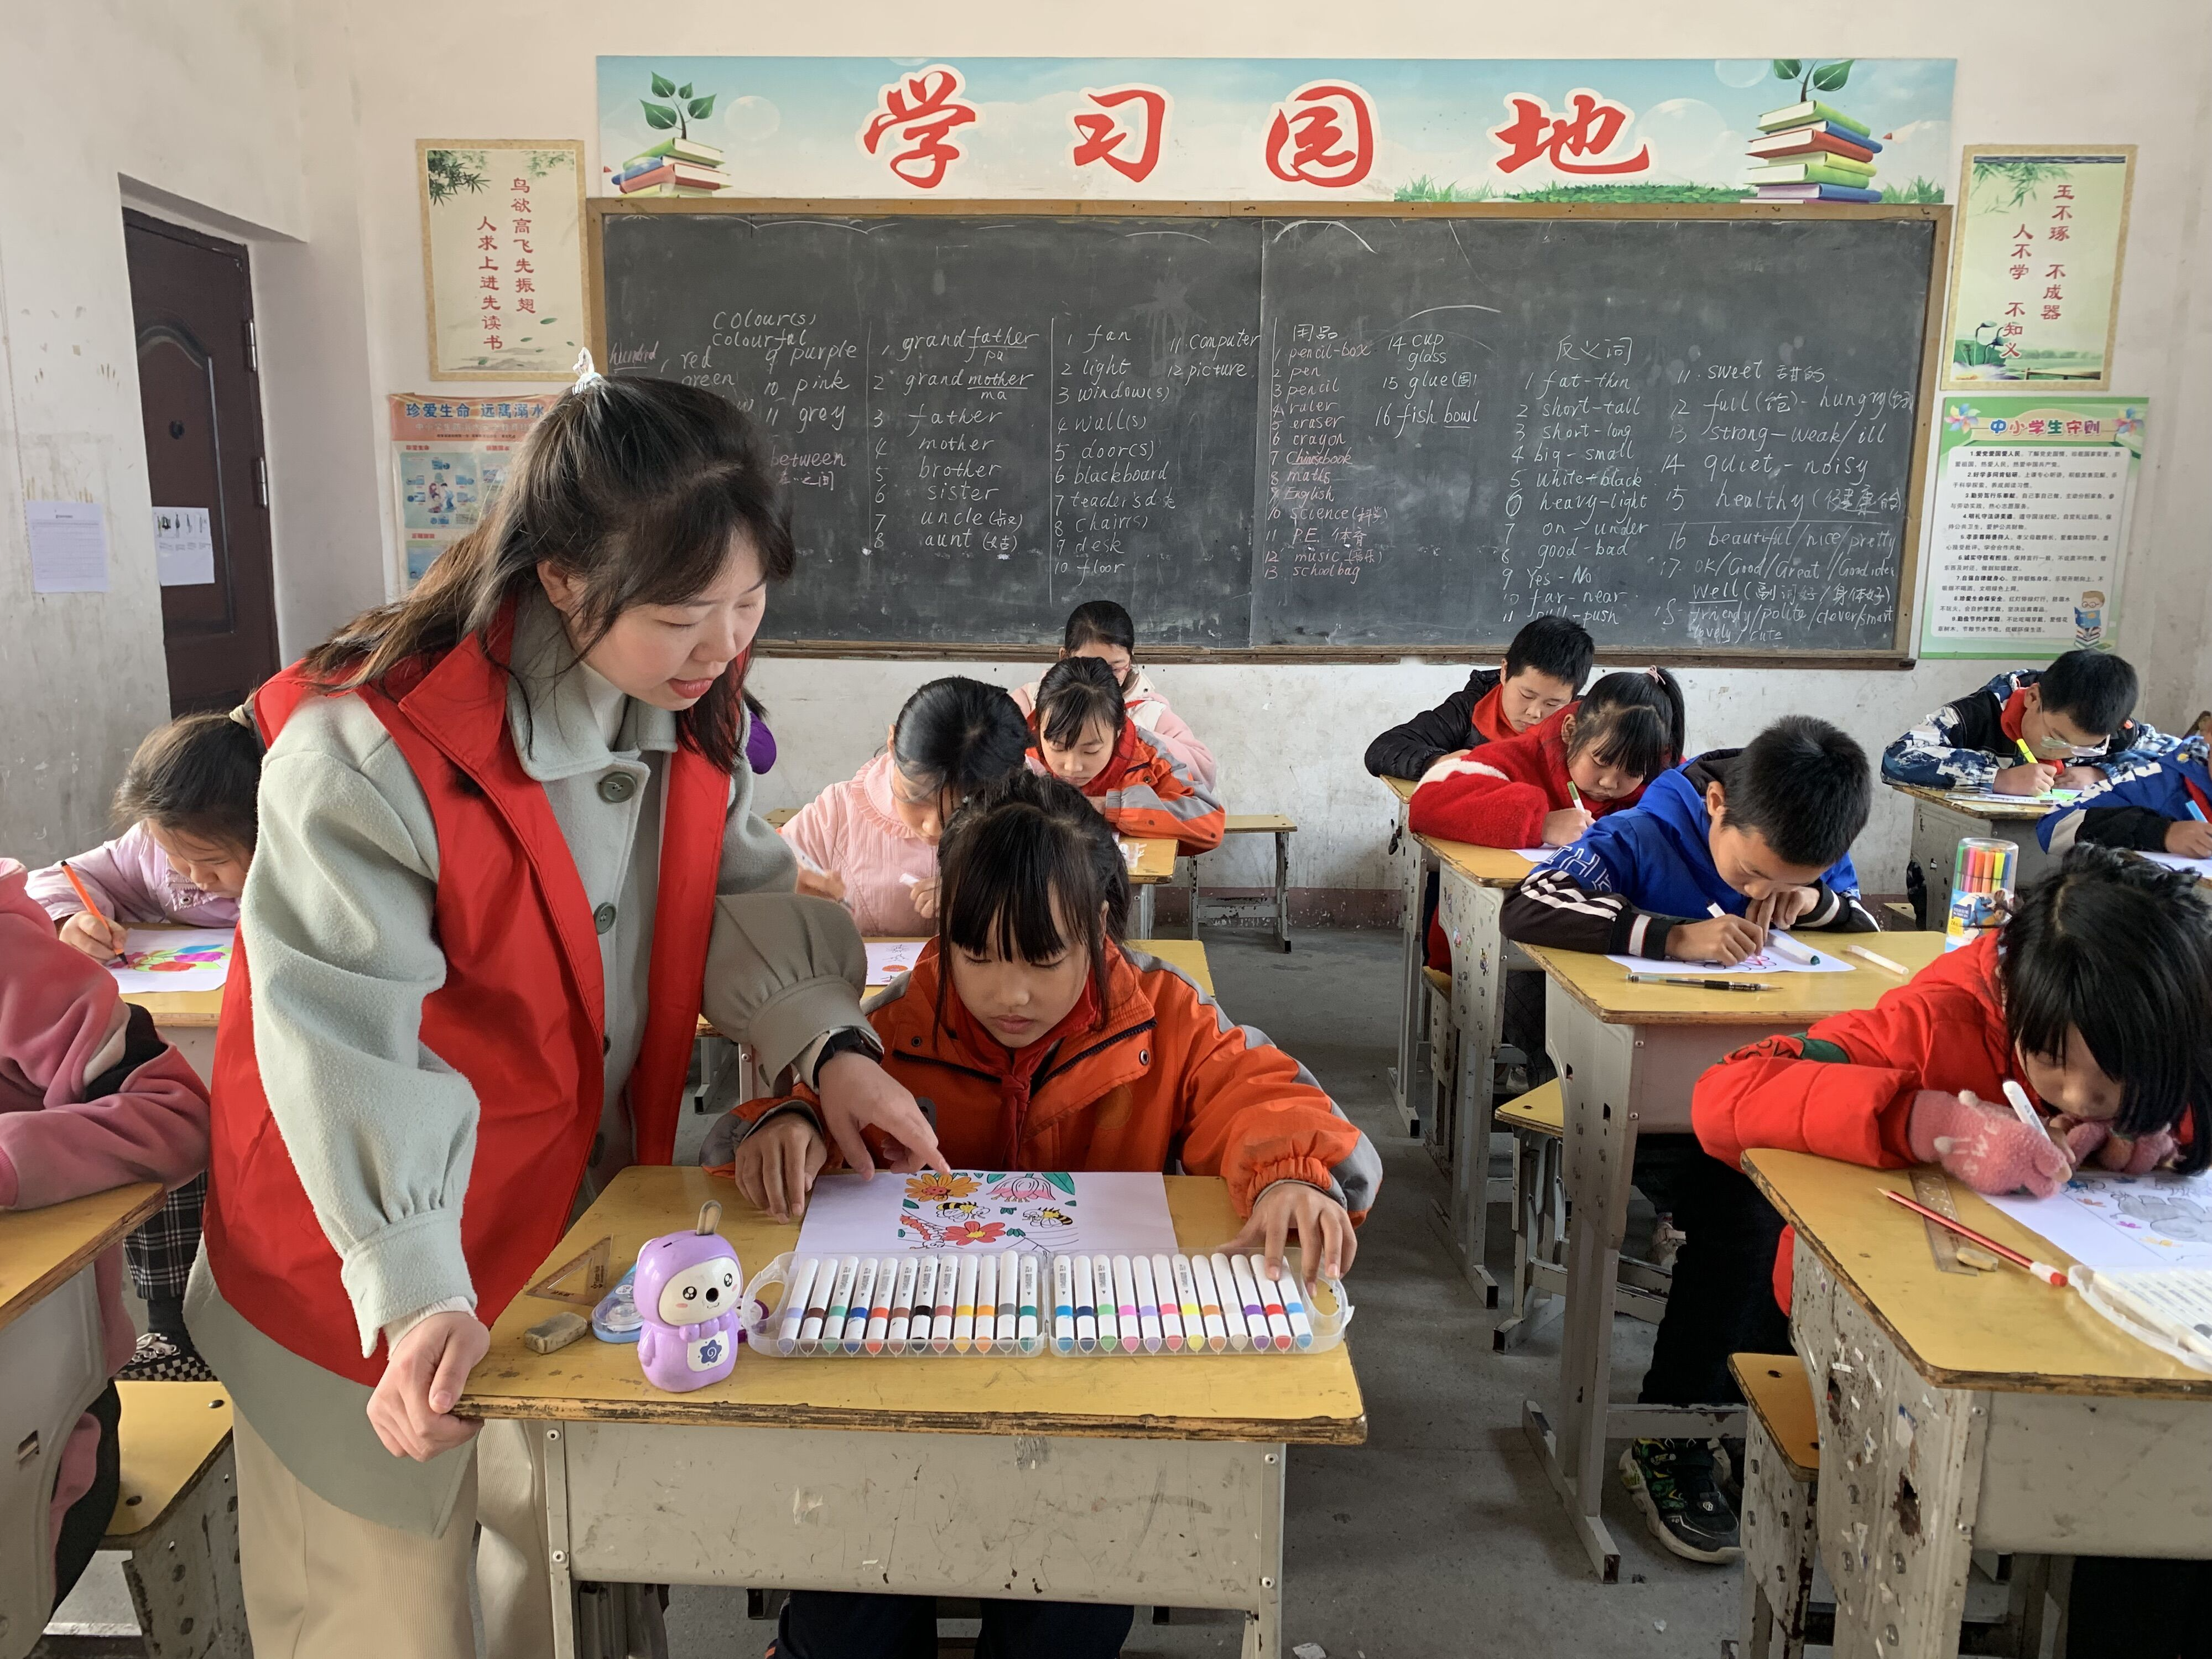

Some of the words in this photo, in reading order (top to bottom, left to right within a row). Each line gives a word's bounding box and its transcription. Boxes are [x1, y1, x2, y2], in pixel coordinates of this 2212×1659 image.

[2049, 185, 2075, 242] 玉不琢
[510, 177, 537, 314] 鸟欲高飞先振翅
[2009, 223, 2034, 280] 人不学
[476, 216, 503, 350] 人求上进先读书
[2041, 264, 2066, 320] 不成器
[1082, 324, 1132, 353] fan
[2001, 301, 2027, 358] 不知义
[790, 340, 857, 370] purple
[896, 325, 1039, 363] grandfather
[1288, 342, 1372, 367] pencil-box
[1388, 336, 1407, 355] 14
[1556, 334, 1633, 366] 反义词
[680, 345, 711, 370] red
[983, 349, 1004, 366] pa
[1407, 349, 1448, 371] glass
[1060, 363, 1073, 376] 2
[1082, 354, 1131, 386] light
[1167, 364, 1184, 378] 12
[1184, 362, 1248, 386] picture
[1273, 368, 1282, 378] 2
[1288, 365, 1321, 384] pen
[1708, 359, 1763, 380] sweet
[792, 370, 850, 405] pink
[873, 376, 884, 391] 2
[903, 368, 1034, 396] grandmother
[1055, 387, 1069, 404] 3
[1077, 379, 1170, 403] window(s)
[1273, 384, 1283, 397] 3
[1285, 377, 1340, 404] pencil
[1383, 376, 1399, 391] 15
[1404, 370, 1448, 400] glue
[1524, 372, 1534, 391] 1
[981, 389, 1007, 401] ma
[406, 403, 470, 418] 珍爱生命
[481, 403, 544, 419] 远离溺水
[1289, 401, 1339, 415] ruler
[1375, 405, 1391, 428] 16
[1393, 399, 1438, 439] fish
[1443, 397, 1480, 424] bowl
[1516, 404, 1529, 418] 2
[1670, 398, 1690, 417] 12
[796, 405, 846, 433] grey
[873, 409, 883, 428] 3
[907, 403, 1003, 438] father
[1057, 416, 1068, 435] 4
[1272, 419, 1283, 431] 5
[1289, 414, 1346, 430] eraser
[1990, 419, 2100, 435] 中小学生守则
[1516, 422, 1526, 441] 3
[1669, 424, 1688, 444] 13
[875, 438, 887, 459] 4
[919, 433, 996, 451] mother
[1054, 443, 1070, 461] 5
[1081, 438, 1154, 461] door(s)
[1272, 434, 1281, 446] 6
[1292, 433, 1347, 454] crayon
[1511, 444, 1524, 464] 4
[771, 445, 846, 467] between
[1269, 450, 1278, 466] 7
[1661, 453, 1685, 475] 14
[876, 467, 888, 482] 5
[919, 455, 1003, 479] brother
[1054, 465, 1065, 484] 6
[1074, 460, 1170, 485] blackboard
[1270, 471, 1280, 485] 8
[1287, 467, 1331, 485] maths
[1510, 469, 1528, 487] 5
[875, 483, 886, 503] 6
[928, 480, 1000, 501] sister
[1282, 486, 1335, 508] English
[1054, 495, 1064, 517] 7
[1666, 485, 1688, 511] 15
[1715, 479, 1804, 528] healthy
[875, 514, 886, 533] 7
[920, 507, 984, 525] uncle
[1267, 506, 1281, 521] 10
[1289, 507, 1349, 527] science
[1054, 520, 1064, 537] 8
[1265, 529, 1277, 542] 11
[1331, 526, 1367, 547] 体育
[1505, 523, 1516, 545] 7
[1669, 521, 1687, 550] 16
[874, 532, 884, 549] 8
[925, 531, 972, 547] aunt
[1056, 538, 1066, 557] 9
[1075, 532, 1126, 554] desk
[1264, 551, 1279, 564] 12
[1294, 549, 1340, 563] music
[1054, 561, 1068, 575] 10
[1076, 557, 1126, 587] floor
[1263, 568, 1278, 580] 13
[1502, 568, 1513, 590] 9
